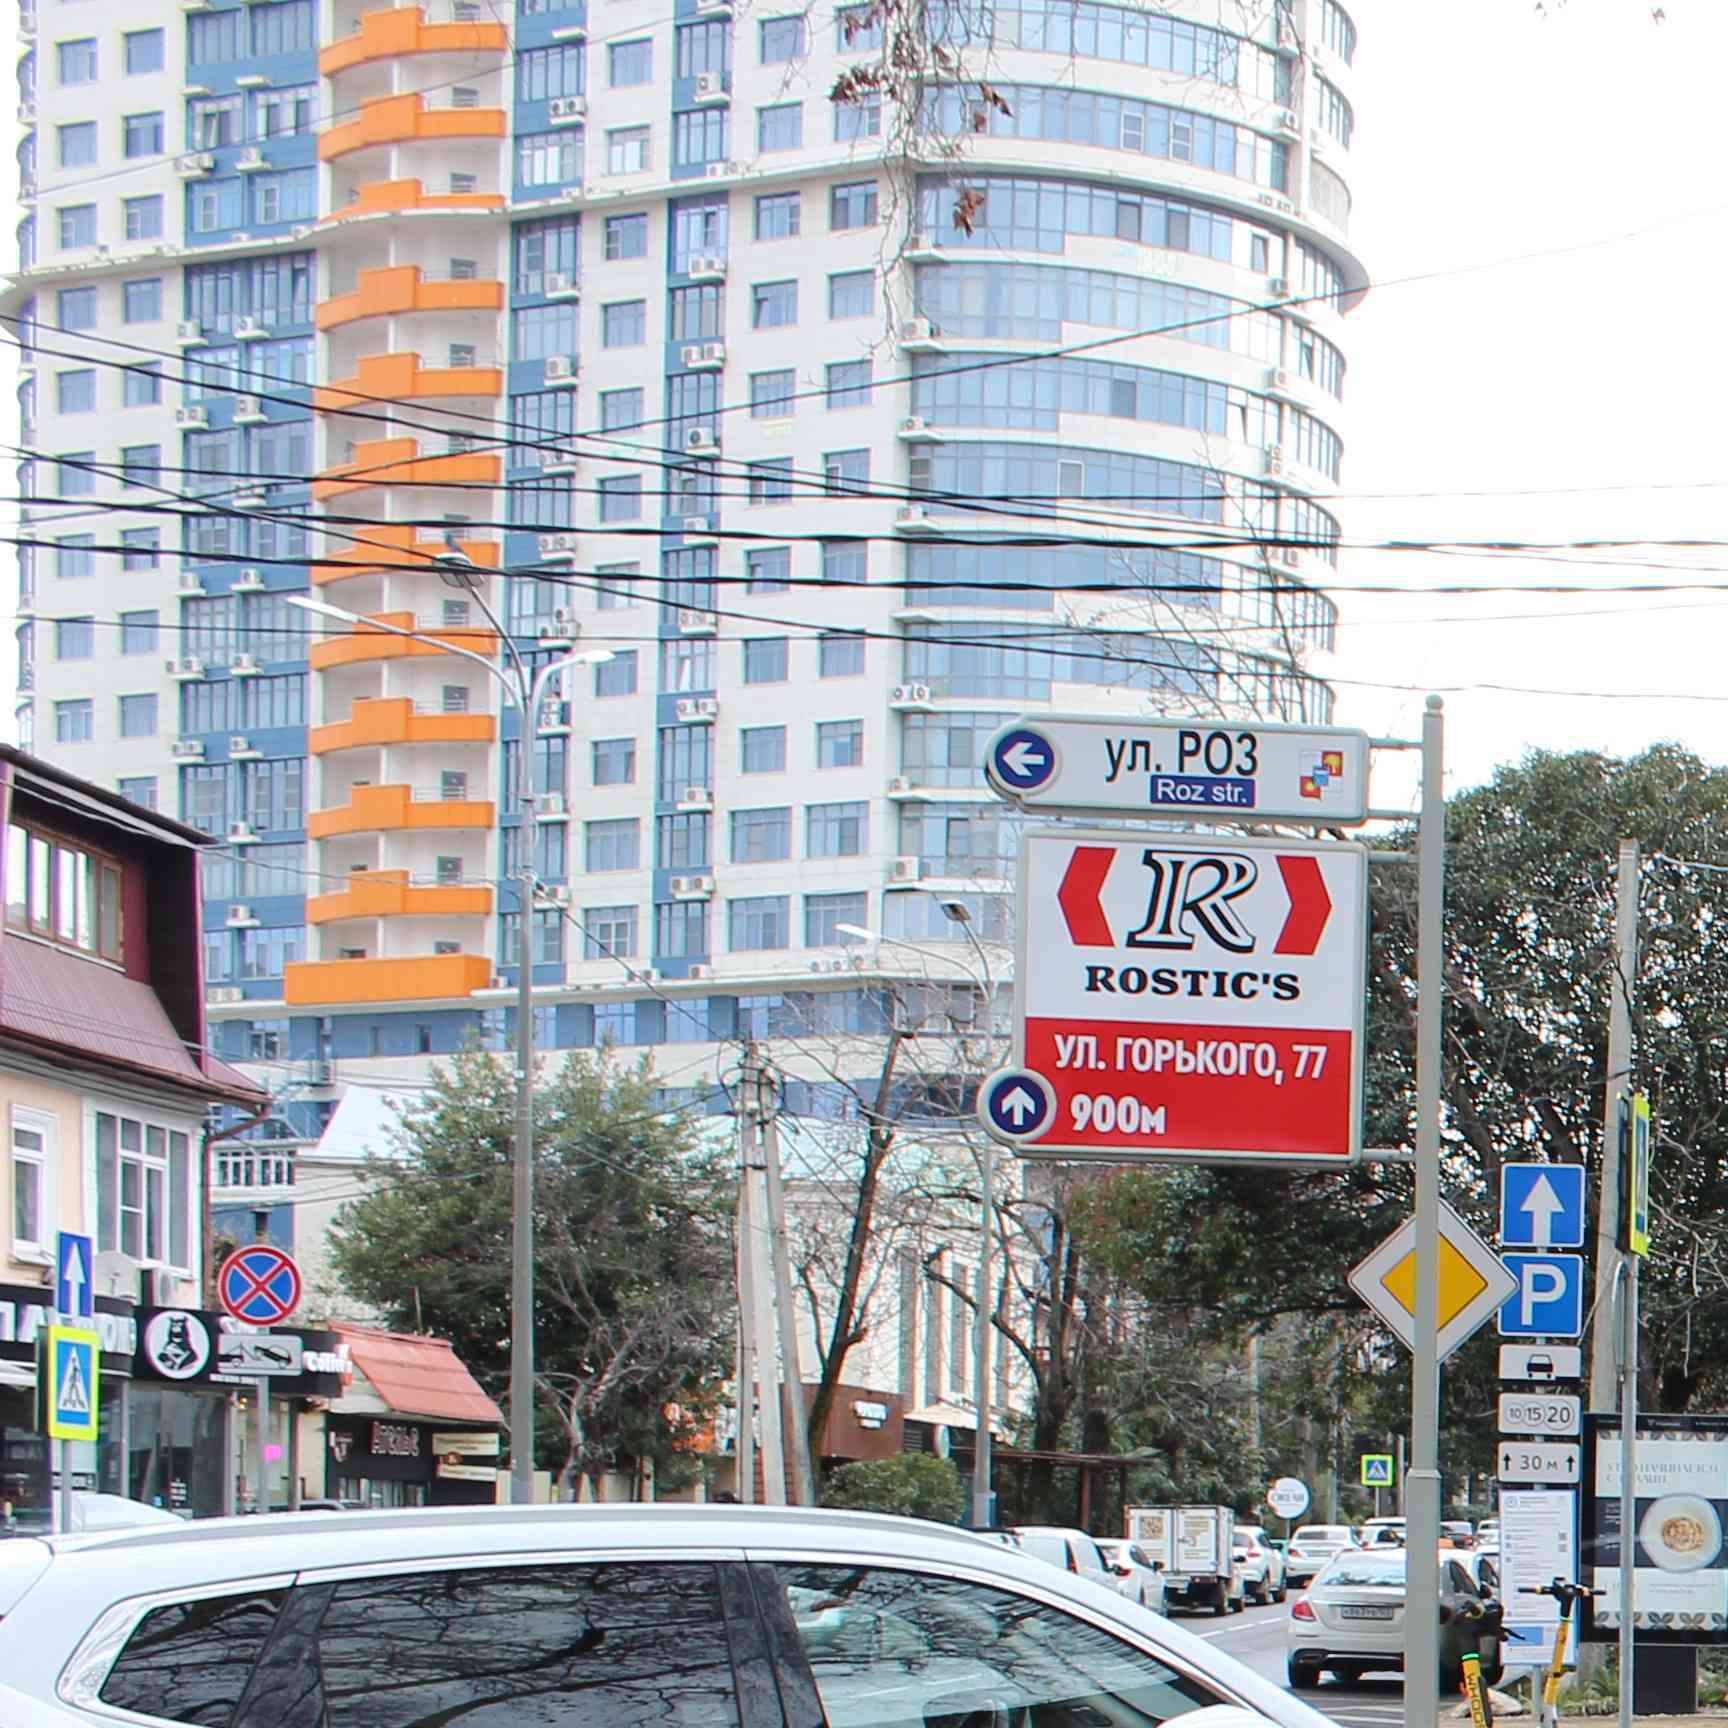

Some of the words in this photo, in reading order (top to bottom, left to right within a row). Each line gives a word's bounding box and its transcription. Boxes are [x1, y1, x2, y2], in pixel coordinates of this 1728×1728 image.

[1106, 738, 1161, 781] ул.
[1178, 731, 1258, 776] РОЗ
[1158, 779, 1205, 801] Roz
[1212, 781, 1247, 804] str.
[1085, 966, 1300, 1000] ROSTIC'S
[1055, 1035, 1106, 1070] УЛ.
[1117, 1039, 1283, 1084] ГОРЬКОГО,
[1293, 1045, 1327, 1079] 77
[1070, 1095, 1165, 1134] 900м
[1528, 1408, 1541, 1421] 15
[1547, 1406, 1570, 1423] 20
[1520, 1455, 1542, 1470] 30
